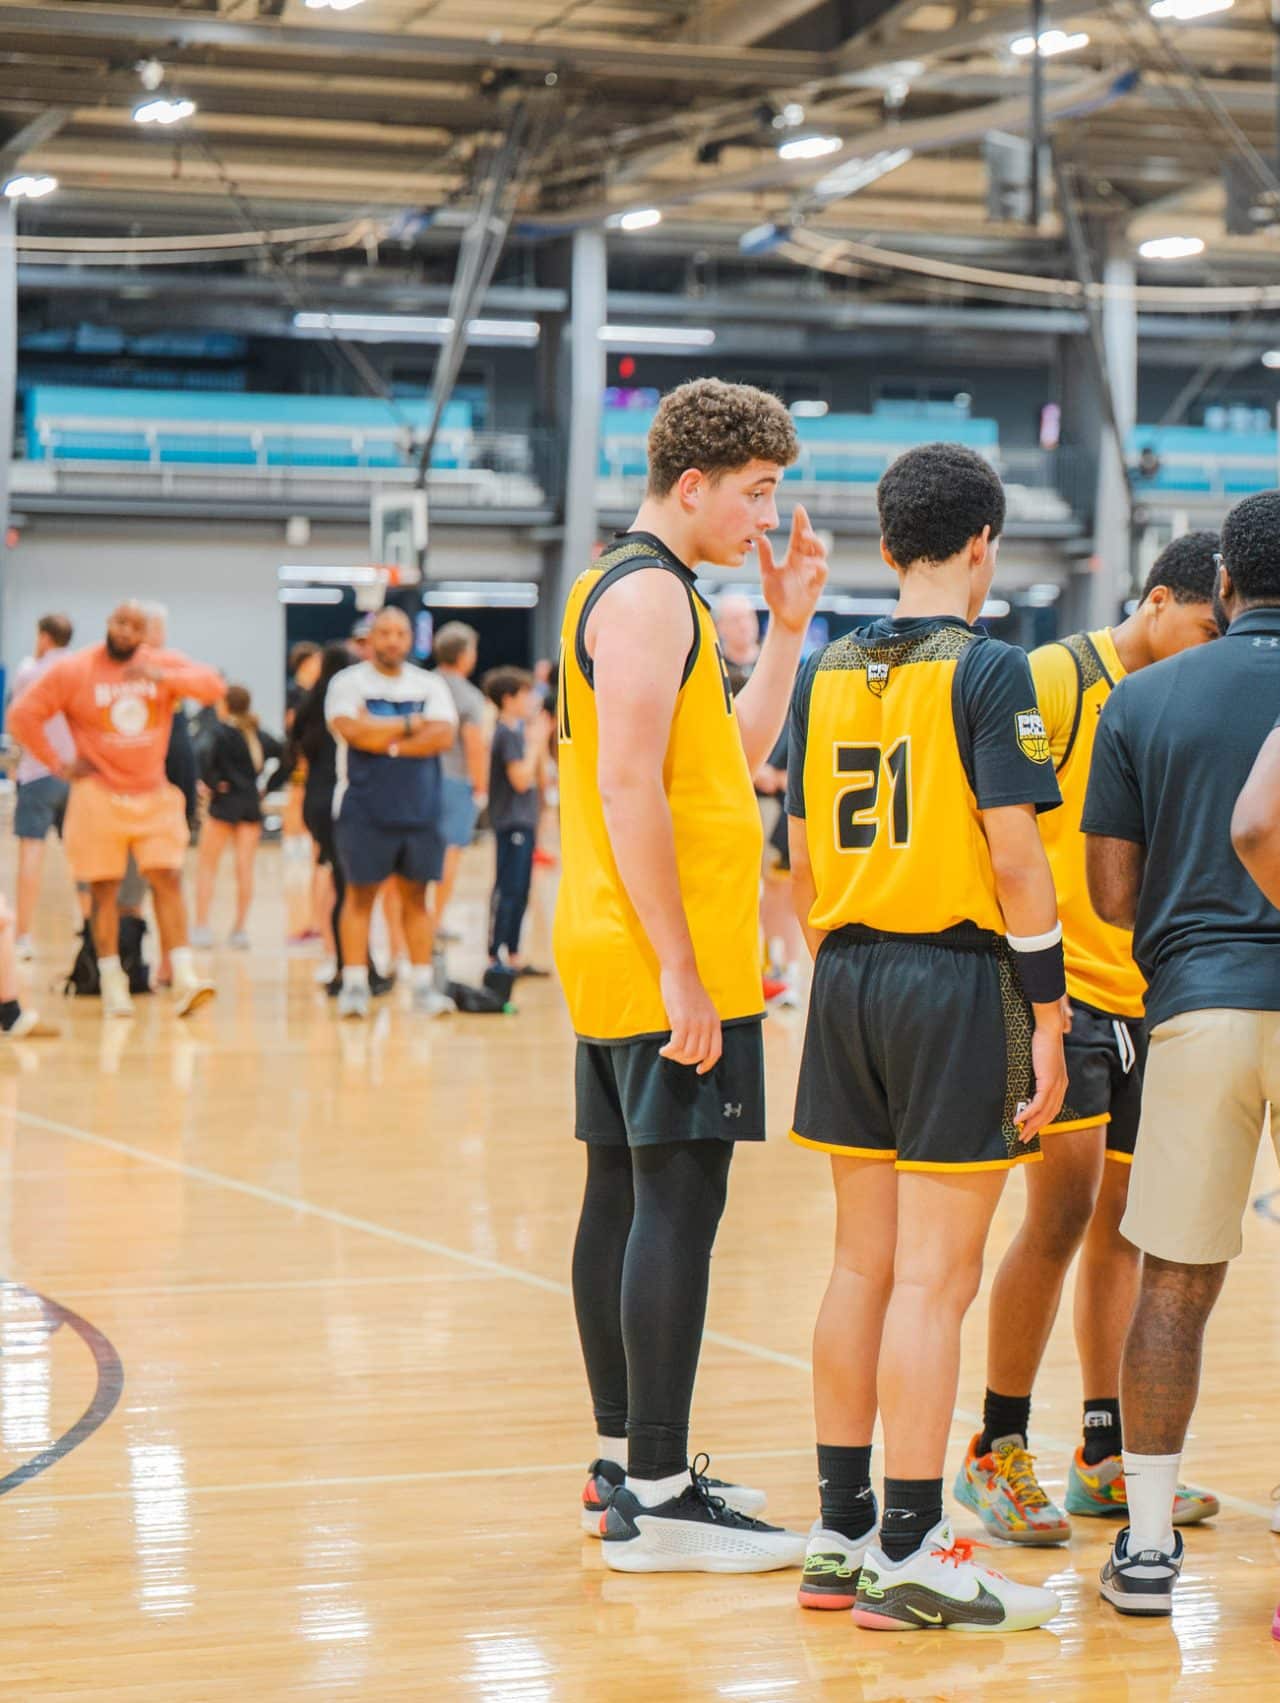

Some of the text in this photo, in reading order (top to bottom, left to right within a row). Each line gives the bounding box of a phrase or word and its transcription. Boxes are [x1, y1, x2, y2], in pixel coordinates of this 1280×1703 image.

[1018, 714, 1043, 728] PR
[832, 735, 912, 854] 21
[1138, 1551, 1161, 1561] NIKE
